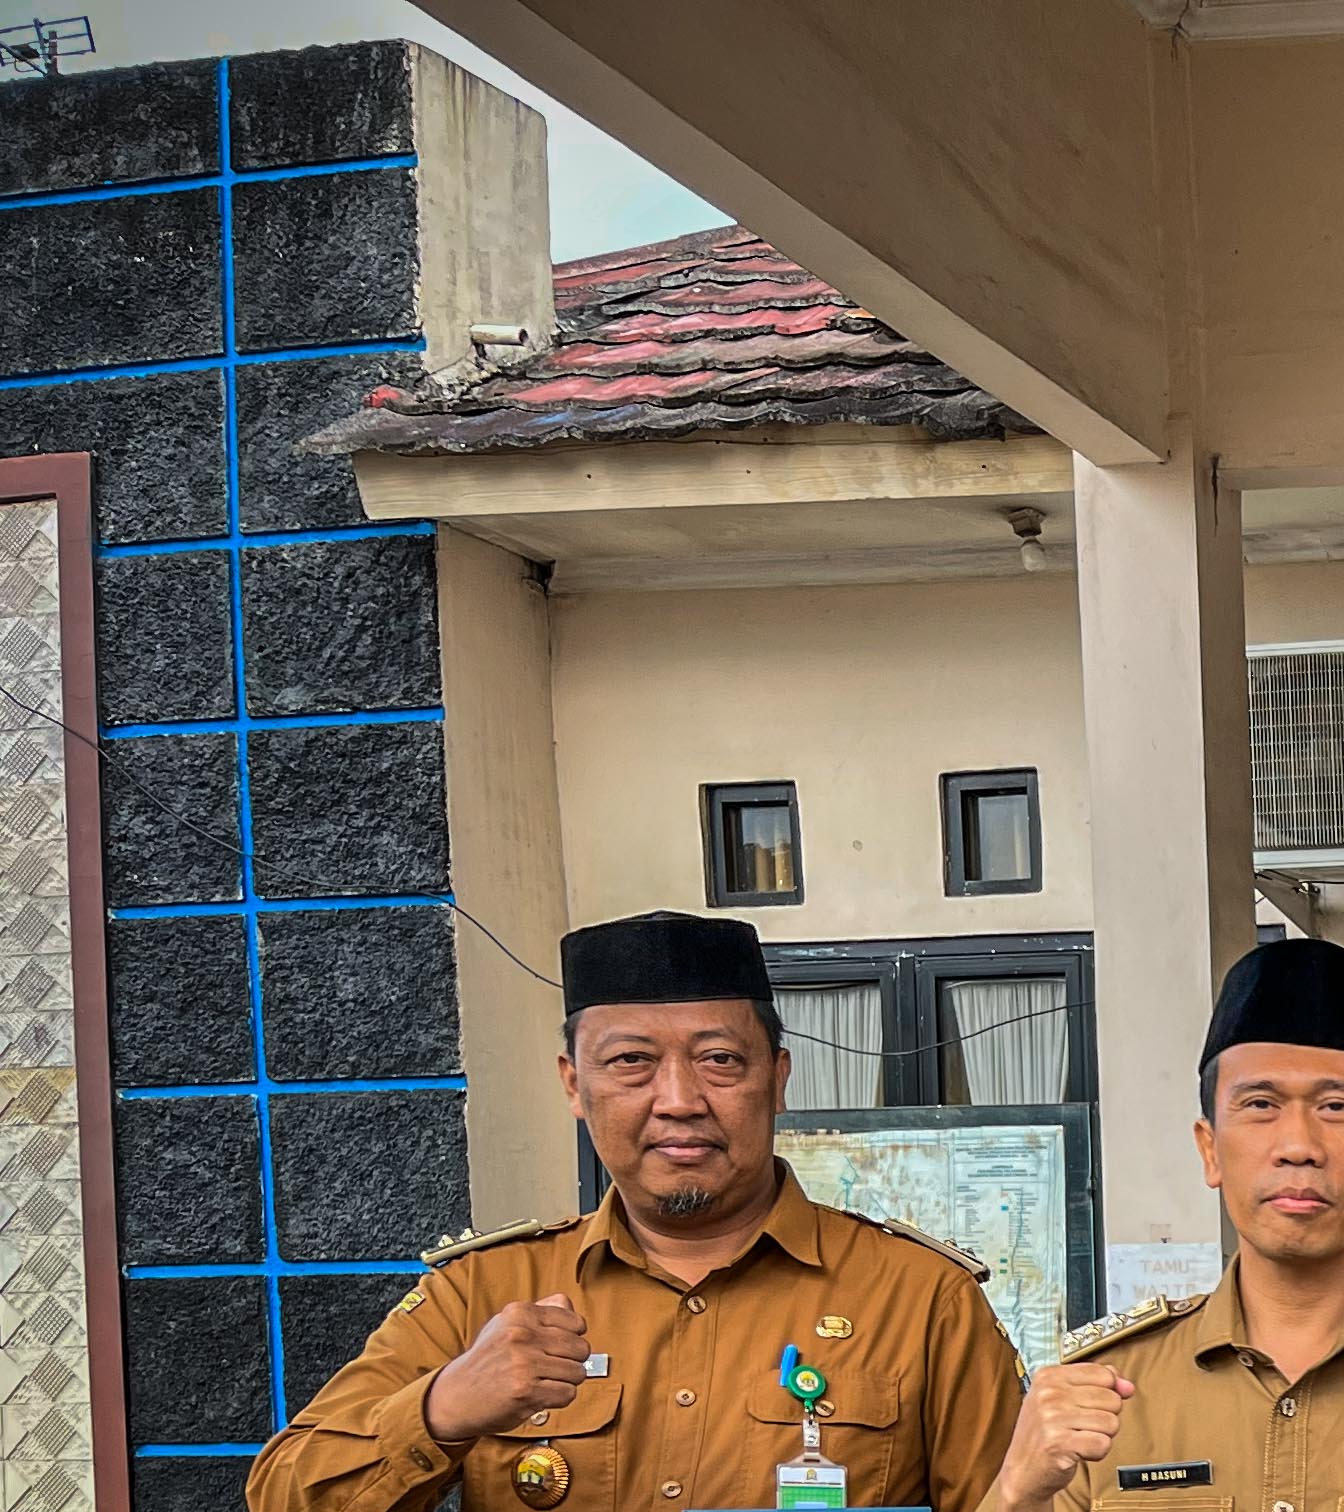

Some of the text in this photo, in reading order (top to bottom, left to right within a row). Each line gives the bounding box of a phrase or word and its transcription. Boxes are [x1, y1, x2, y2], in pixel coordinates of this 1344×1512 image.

[1139, 1259, 1190, 1274] TAMU
[1141, 1469, 1187, 1482] H BASUNI
